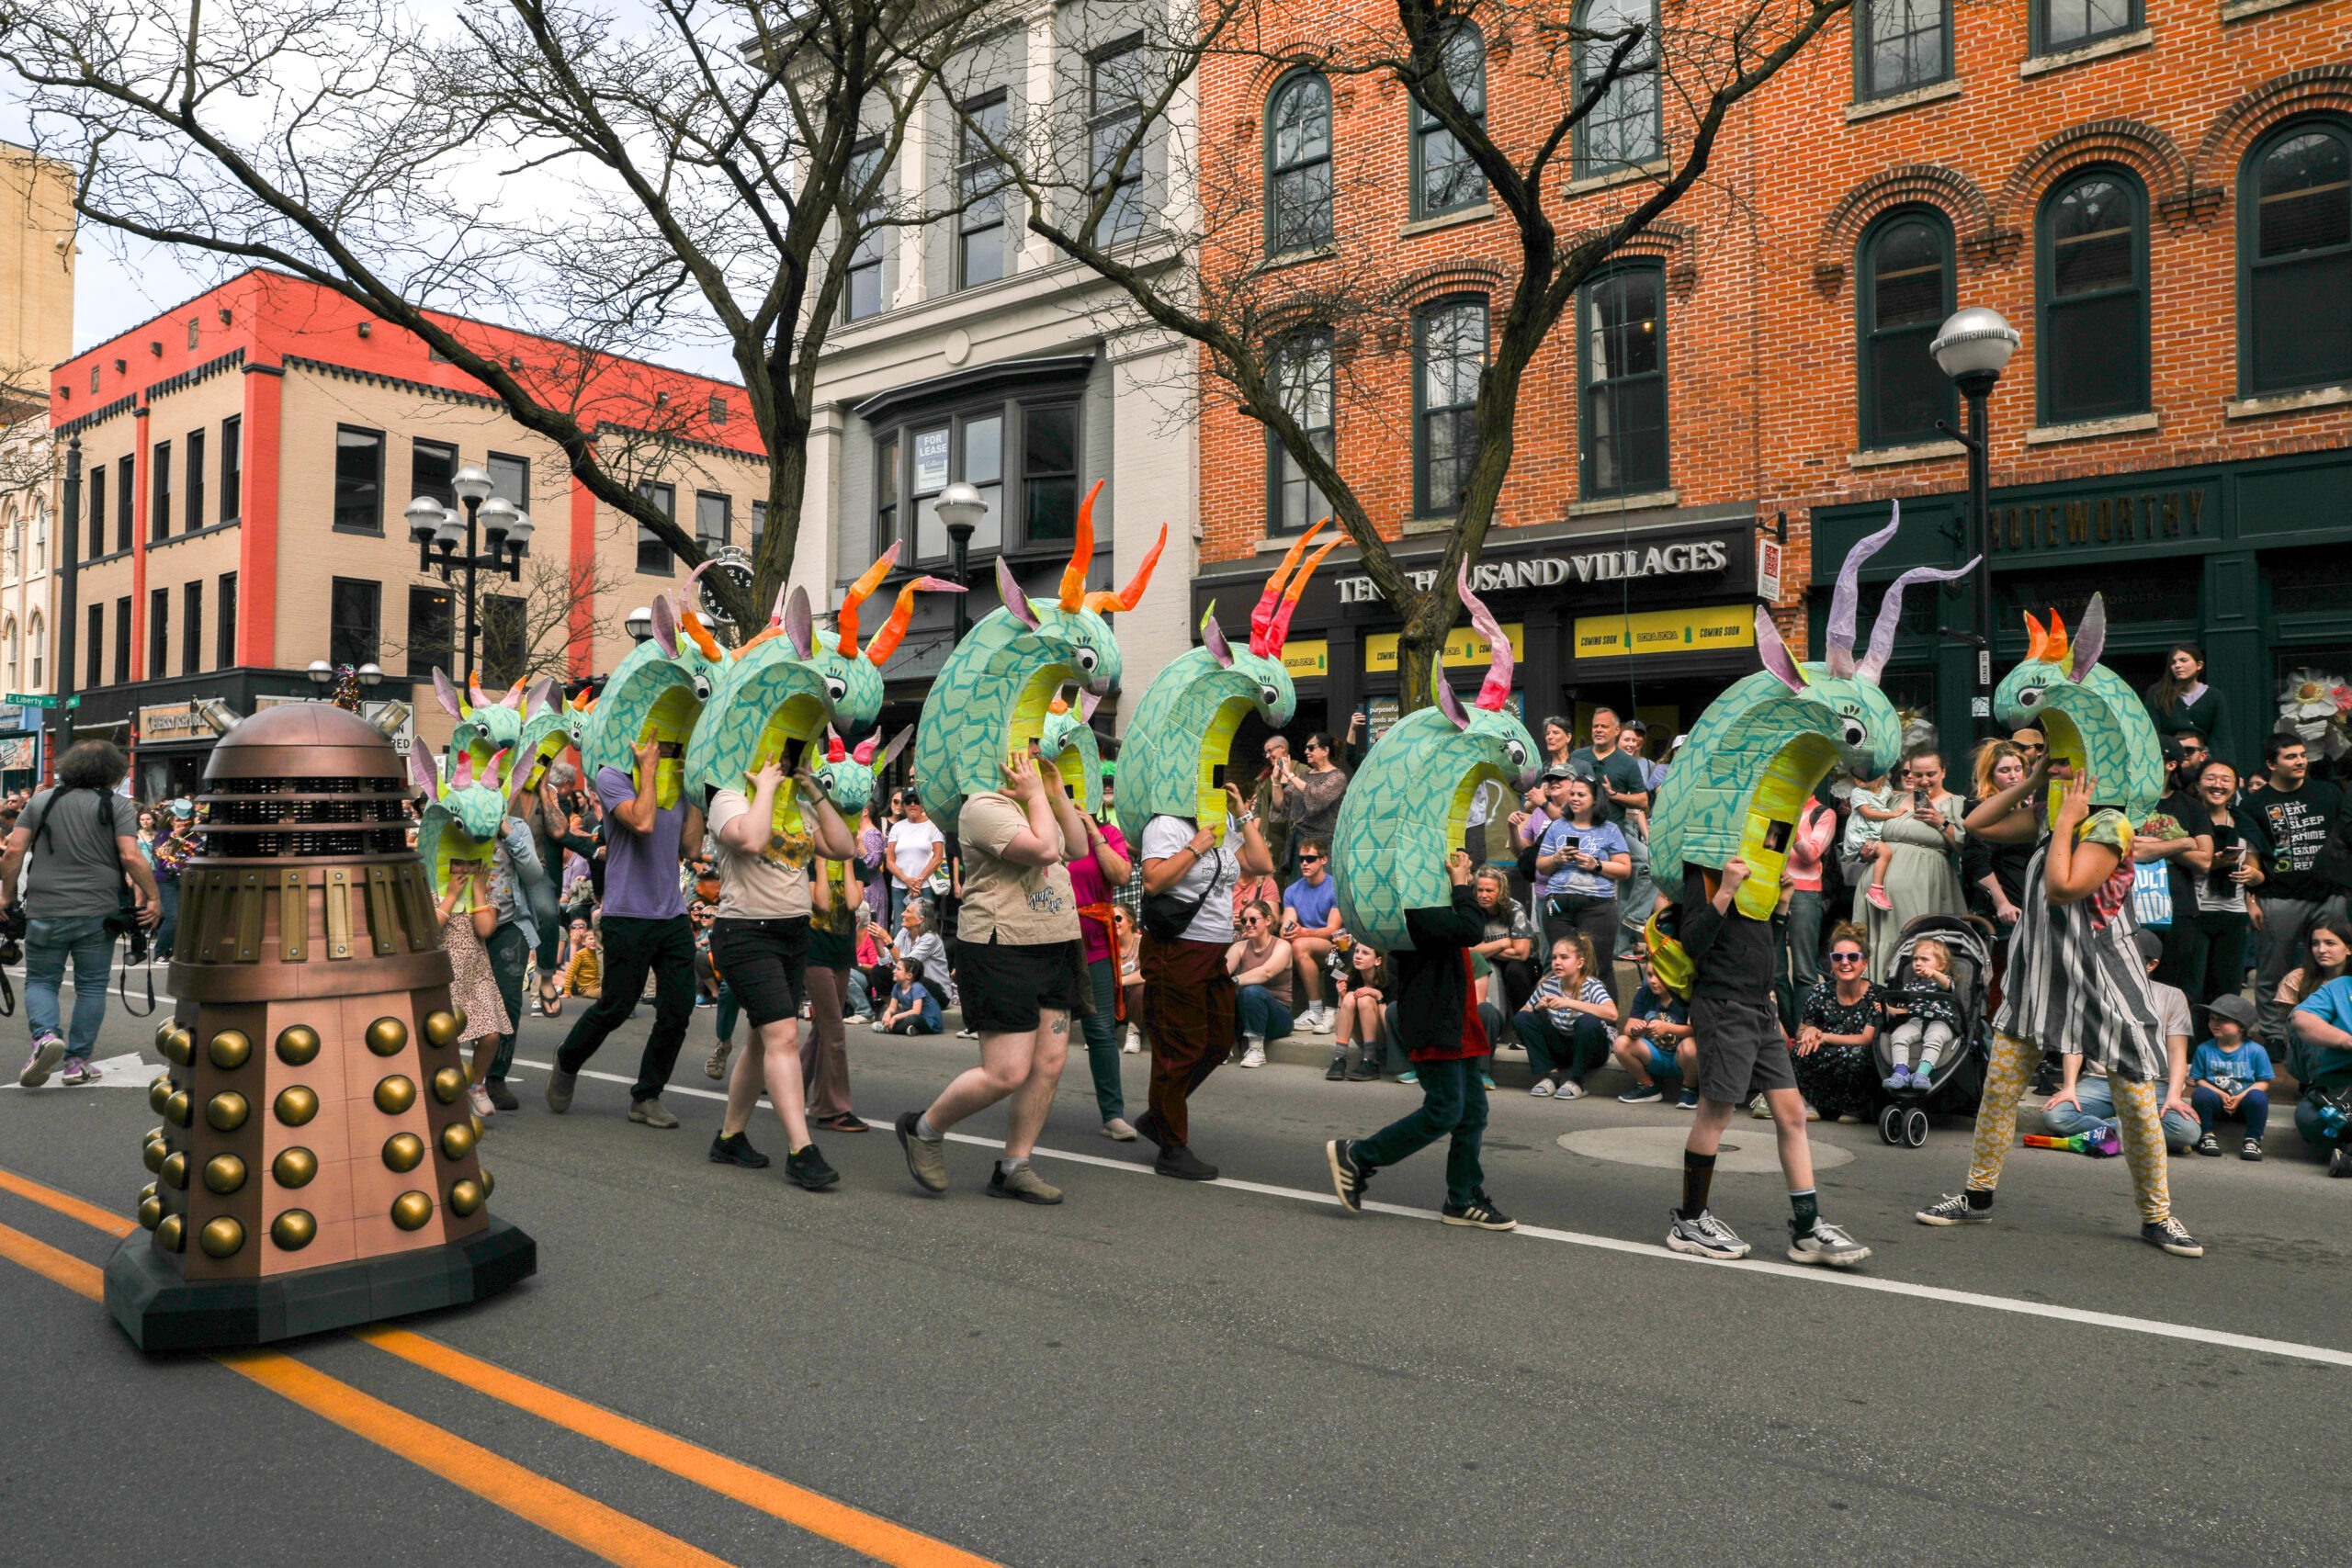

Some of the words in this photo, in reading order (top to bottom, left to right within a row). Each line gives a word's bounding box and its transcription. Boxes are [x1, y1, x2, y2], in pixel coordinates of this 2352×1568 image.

[923, 434, 942, 446] FOR
[919, 444, 947, 457] LEASE
[1571, 541, 1727, 582] VILLAGES
[1636, 632, 1657, 642] BORA
[1657, 630, 1679, 641] BORA
[1700, 627, 1723, 637] COMING
[1724, 626, 1740, 636] SOON
[1580, 637, 1601, 646] COMING
[1602, 635, 1618, 645] SOON
[1376, 651, 1396, 660] COMING
[16, 695, 43, 706] Liberty
[1369, 705, 1399, 714] purposeful
[1369, 716, 1386, 725] goods
[2285, 804, 2308, 816] EAT
[2289, 815, 2325, 829] SLEEP
[2290, 830, 2326, 843] ANIME
